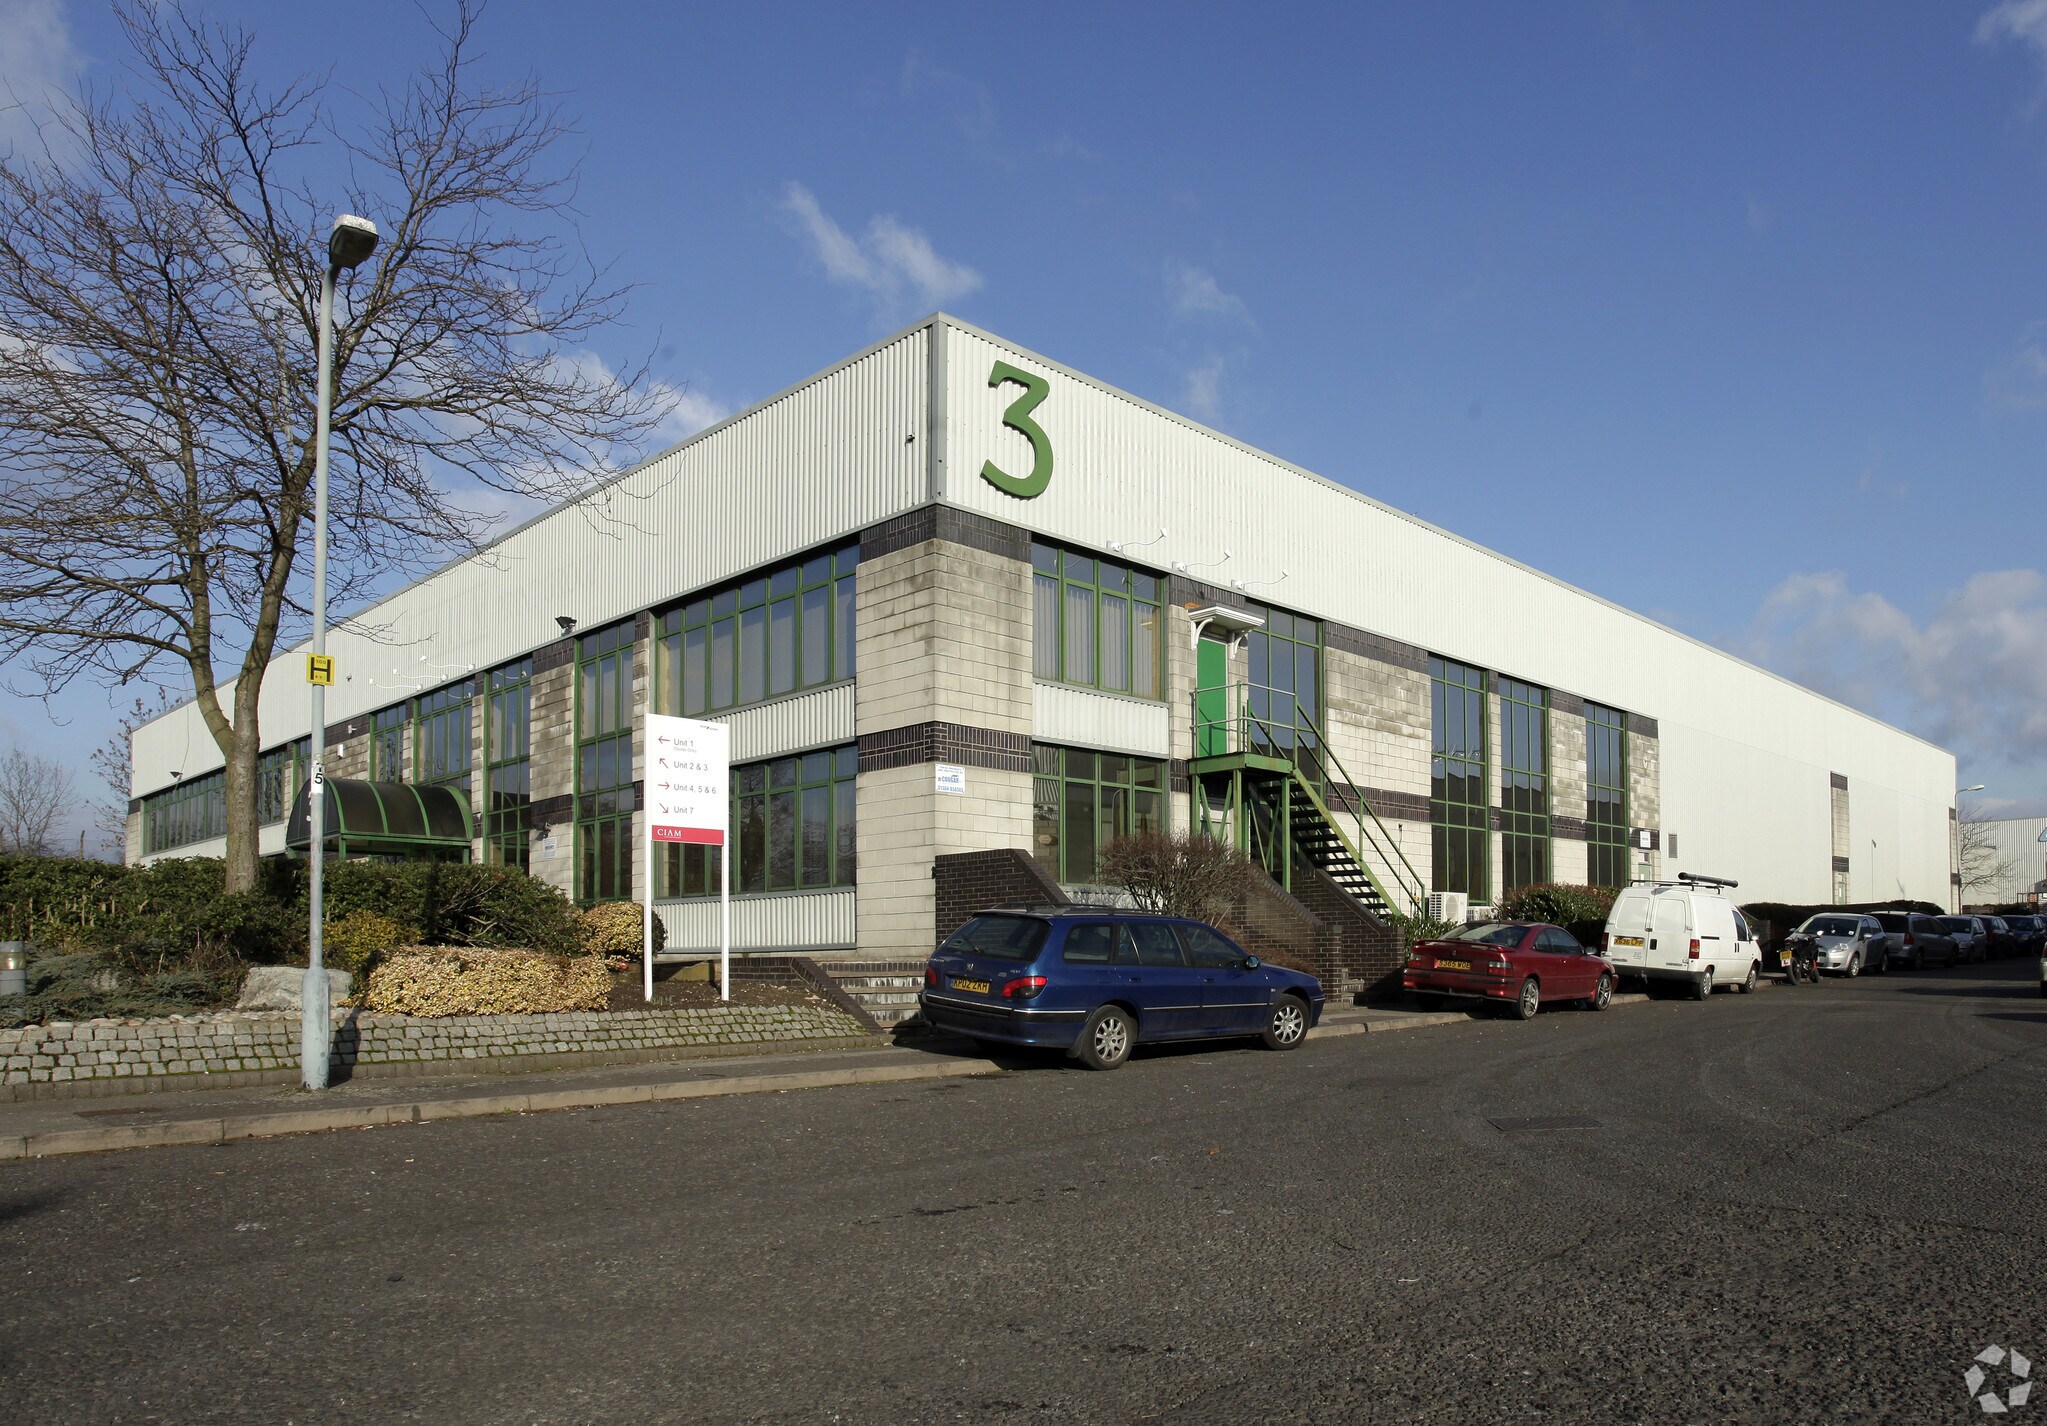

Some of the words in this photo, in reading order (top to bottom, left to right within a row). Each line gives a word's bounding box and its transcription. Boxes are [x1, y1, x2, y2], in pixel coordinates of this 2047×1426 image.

[980, 360, 1053, 498] 3
[310, 656, 331, 682] H
[674, 738, 688, 747] Unit
[674, 761, 688, 770] Unit
[689, 762, 694, 770] 2
[696, 763, 701, 771] &
[674, 783, 688, 792] Unit
[705, 786, 710, 794] &
[674, 806, 688, 814] Unit
[657, 828, 682, 837] CIAM
